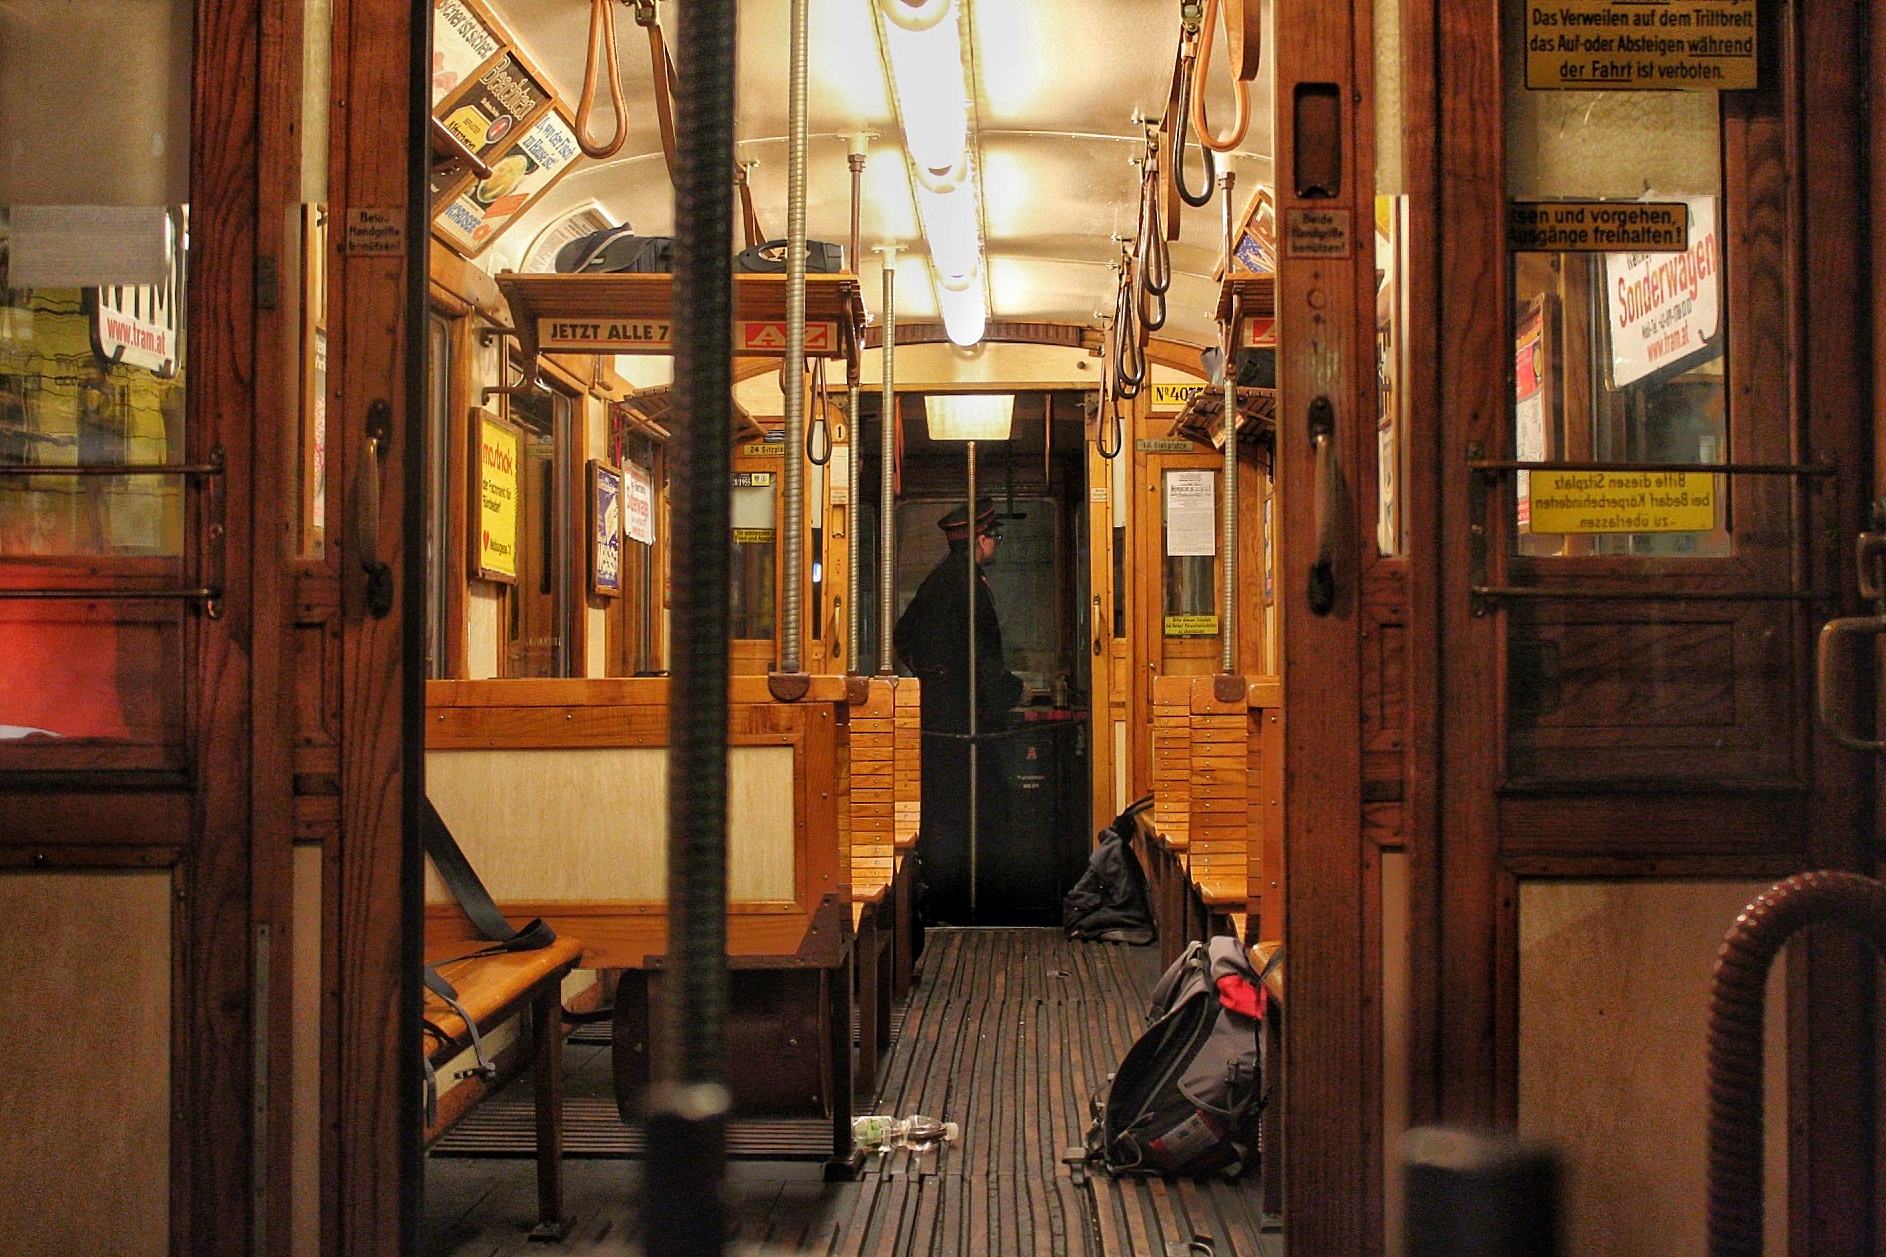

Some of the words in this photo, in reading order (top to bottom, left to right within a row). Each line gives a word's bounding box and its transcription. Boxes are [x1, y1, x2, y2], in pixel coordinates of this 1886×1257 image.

[1532, 9, 1557, 26] Das
[1561, 9, 1628, 27] Verweilen
[1633, 9, 1655, 26] auf
[1659, 8, 1691, 27] dem
[1530, 35, 1554, 51] das
[1617, 34, 1684, 56] Absteigen
[1688, 35, 1753, 53] während
[1560, 60, 1583, 78] der
[1591, 60, 1632, 79] Fahrt
[1637, 60, 1655, 78] ist
[1658, 60, 1725, 80] verboten.
[479, 53, 537, 121] Beachten
[1302, 212, 1333, 225] Beide
[1554, 207, 1585, 224] und
[1590, 208, 1677, 227] vorgehen,
[1594, 226, 1682, 244] freihalten!
[1618, 233, 1717, 328] Sonderwagen
[107, 318, 166, 356] www.tram.at
[551, 323, 600, 339] JETZT
[607, 325, 653, 340] ALLE
[747, 325, 826, 346] AZ
[1647, 319, 1690, 362] www.tram.at
[750, 446, 759, 454] 24
[761, 445, 784, 455] Sitzplä
